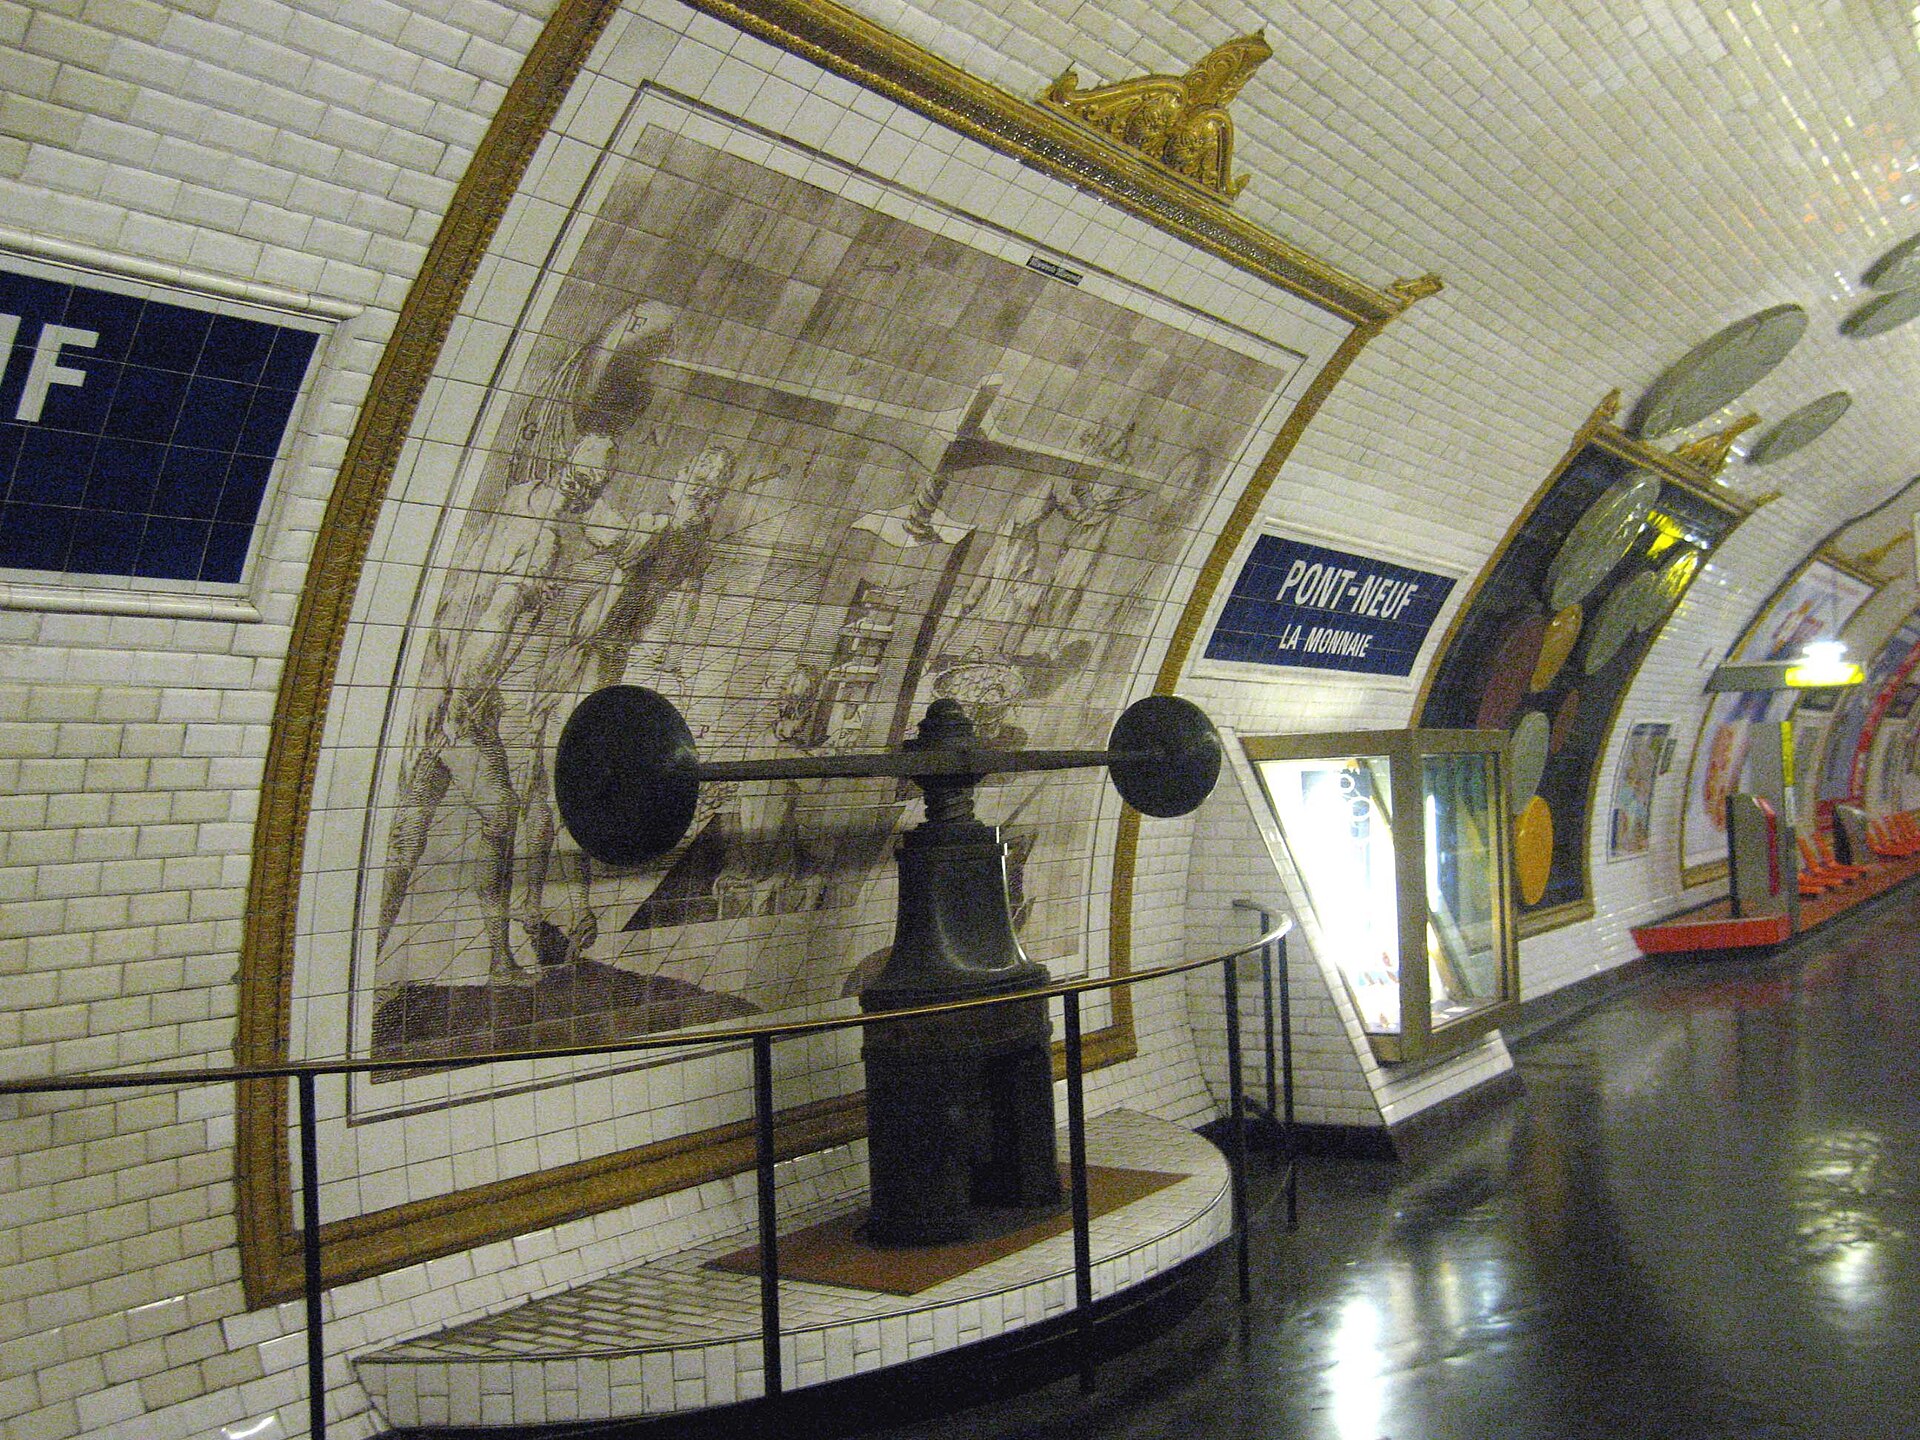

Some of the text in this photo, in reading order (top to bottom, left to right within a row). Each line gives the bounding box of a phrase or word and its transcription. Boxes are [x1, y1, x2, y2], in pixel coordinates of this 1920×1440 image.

[0, 312, 100, 423] F
[1276, 559, 1419, 620] PONT-NEUF
[1278, 623, 1374, 658] LA MONNAIE
